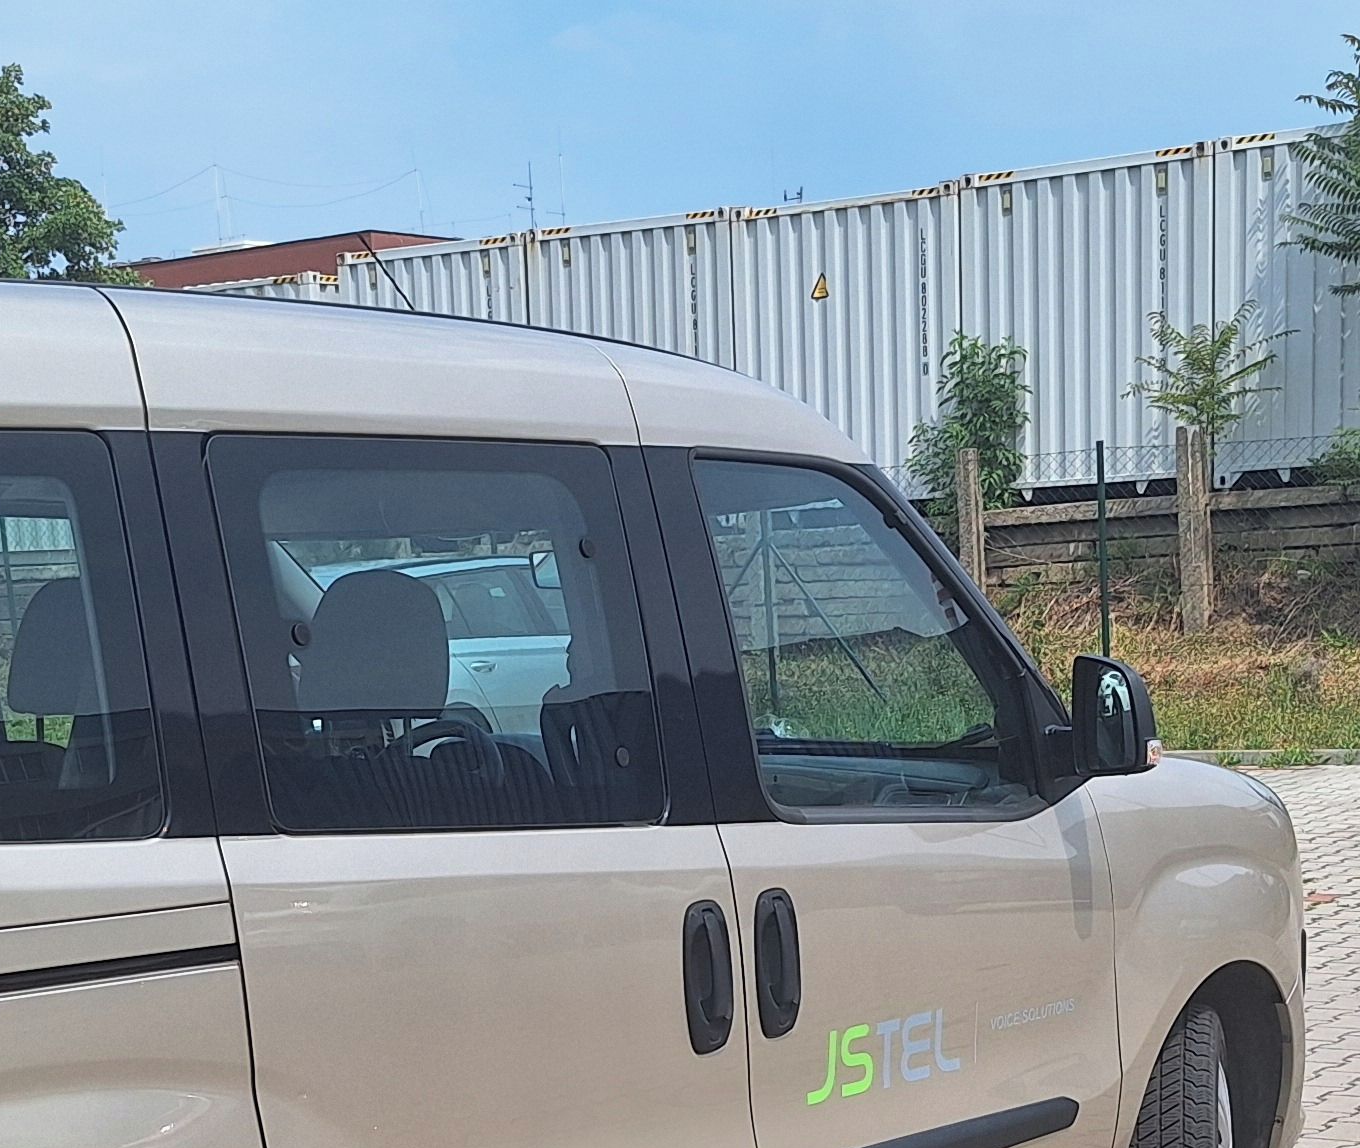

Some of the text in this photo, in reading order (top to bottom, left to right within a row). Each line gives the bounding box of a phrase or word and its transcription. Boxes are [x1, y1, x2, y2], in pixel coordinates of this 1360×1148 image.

[990, 998, 1076, 1030] VOICE SOLUTIONS
[806, 1008, 960, 1105] JSTEL
